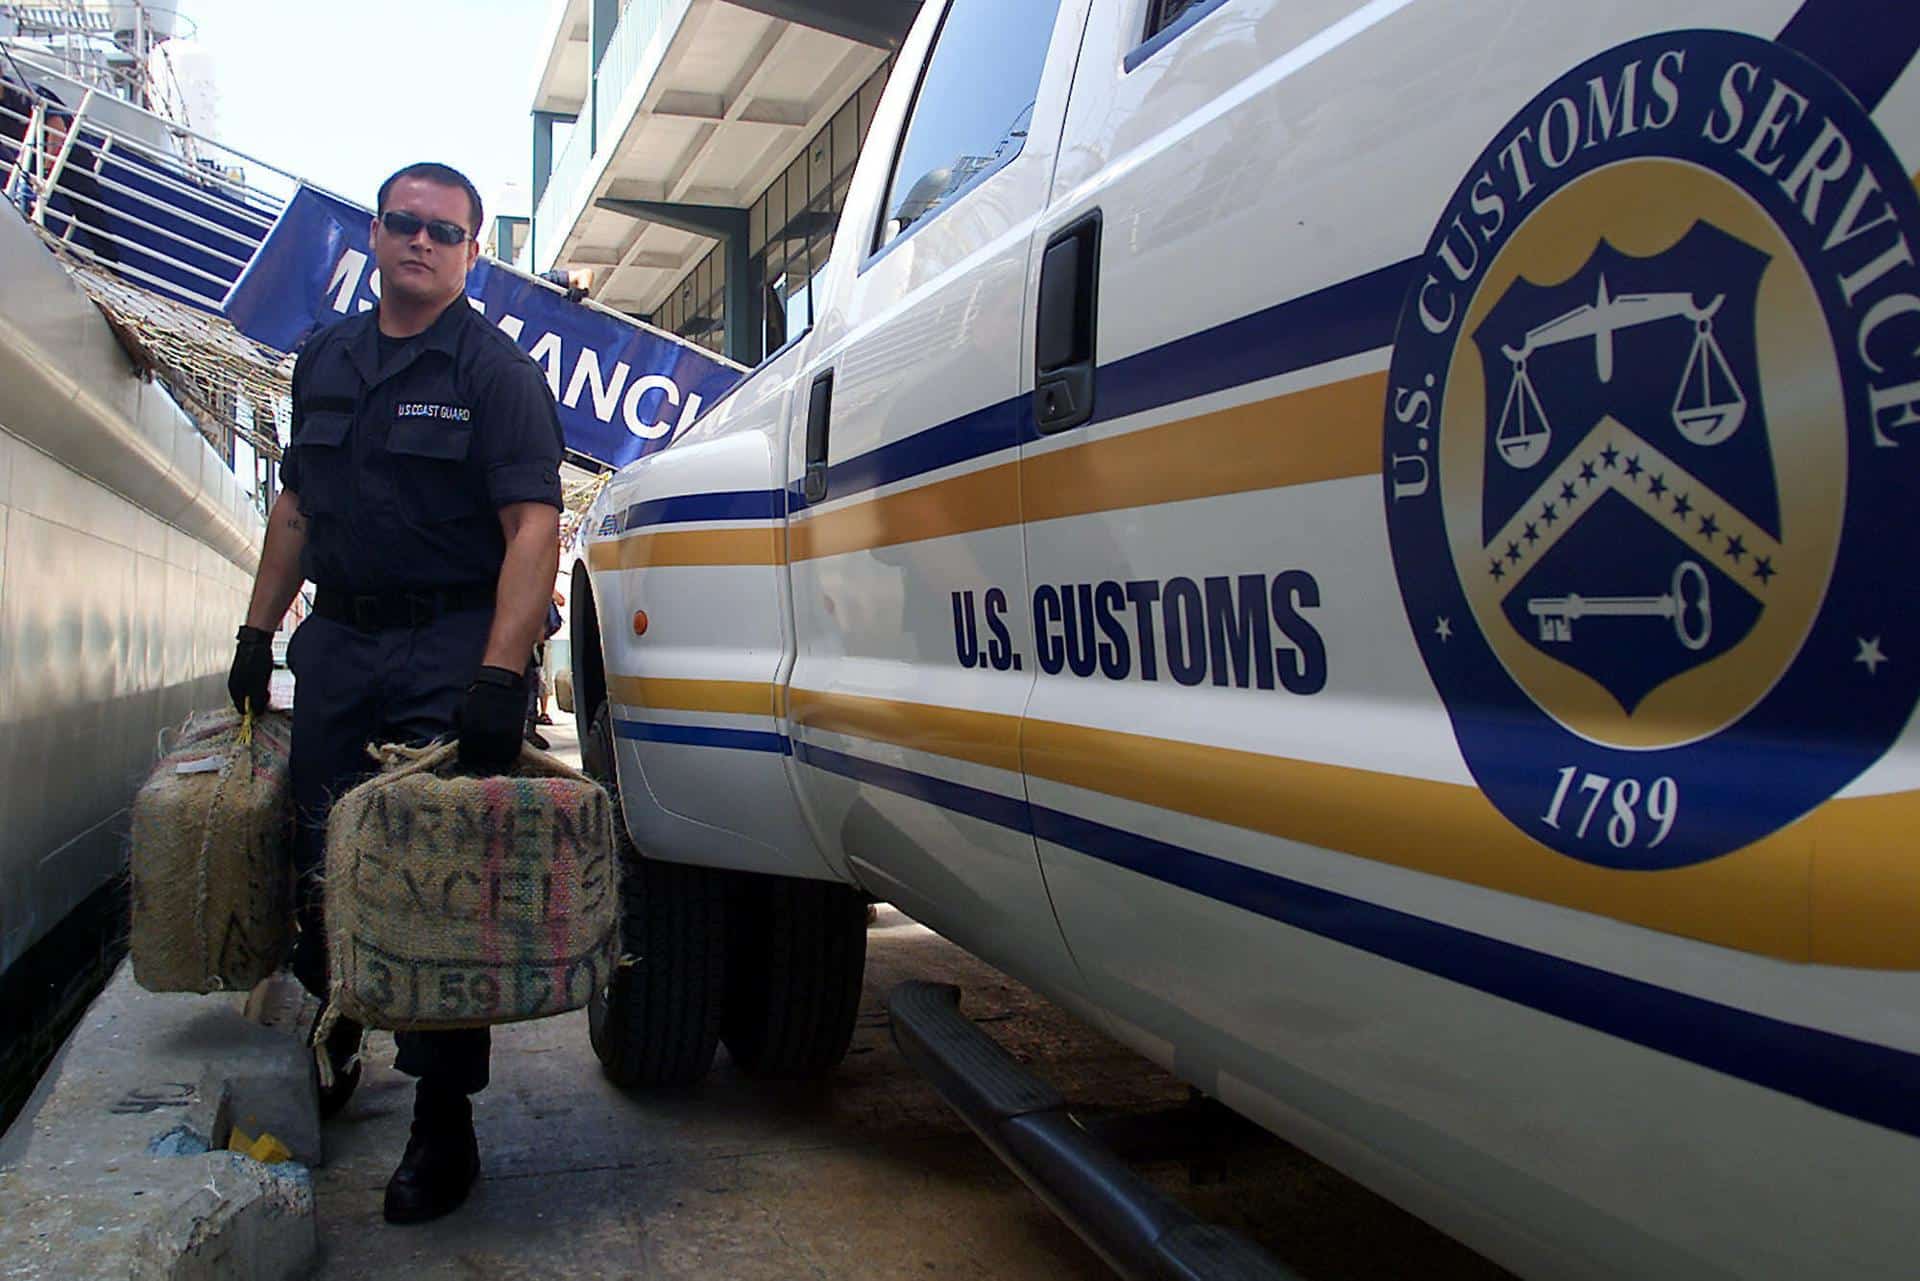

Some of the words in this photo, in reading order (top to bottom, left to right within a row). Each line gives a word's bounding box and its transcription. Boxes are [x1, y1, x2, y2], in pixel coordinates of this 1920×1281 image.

[1393, 372, 1435, 502] U.S.
[1419, 50, 1686, 335] CUSTOMS
[1702, 61, 1920, 448] SERVICE
[411, 404, 440, 417] COAST
[440, 406, 470, 421] GUARD
[951, 588, 1022, 671] U.S.
[1033, 569, 1327, 695] CUSTOMS
[1540, 766, 1678, 849] 1789
